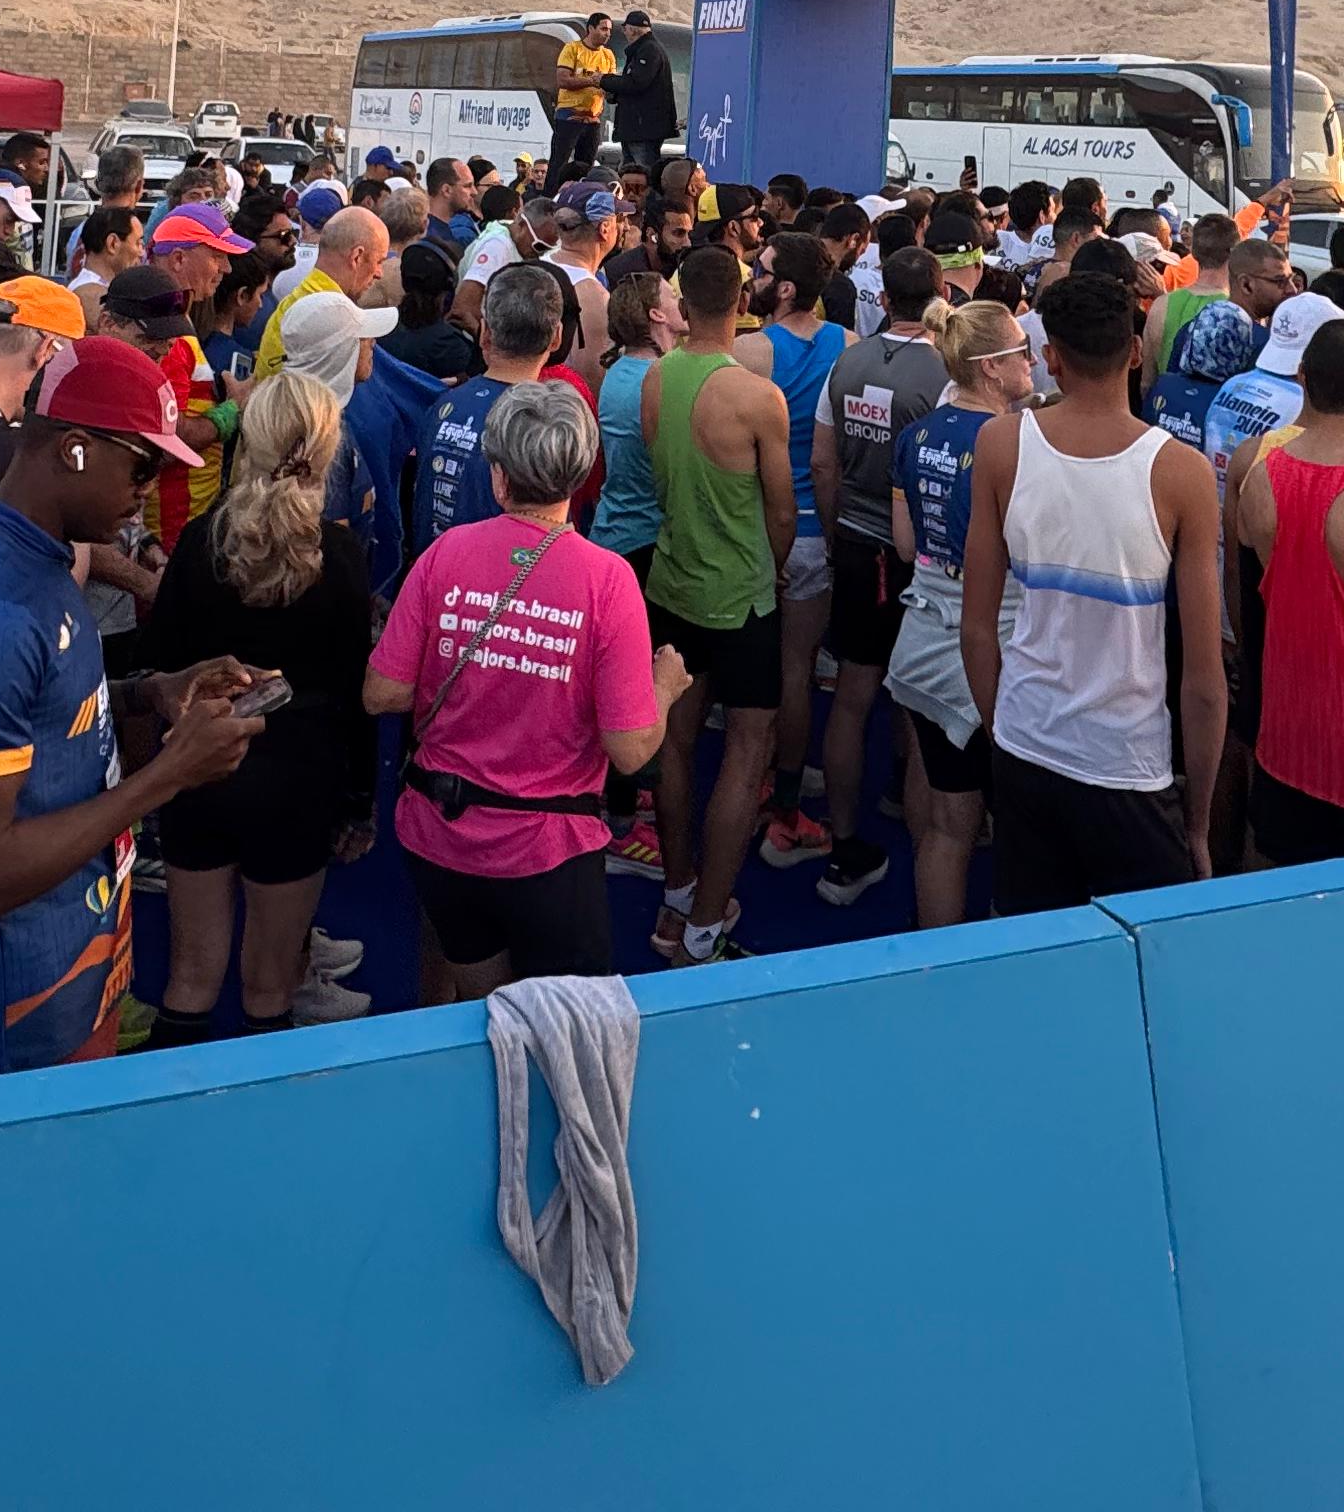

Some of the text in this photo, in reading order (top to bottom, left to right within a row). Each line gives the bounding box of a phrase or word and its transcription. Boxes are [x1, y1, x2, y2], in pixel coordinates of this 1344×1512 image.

[459, 98, 531, 131] Alfriend voyage
[1022, 137, 1136, 160] AL AQSA TOURS
[847, 399, 889, 423] MOEX
[844, 420, 892, 445] GROUP
[464, 590, 585, 630] majrs.brasil
